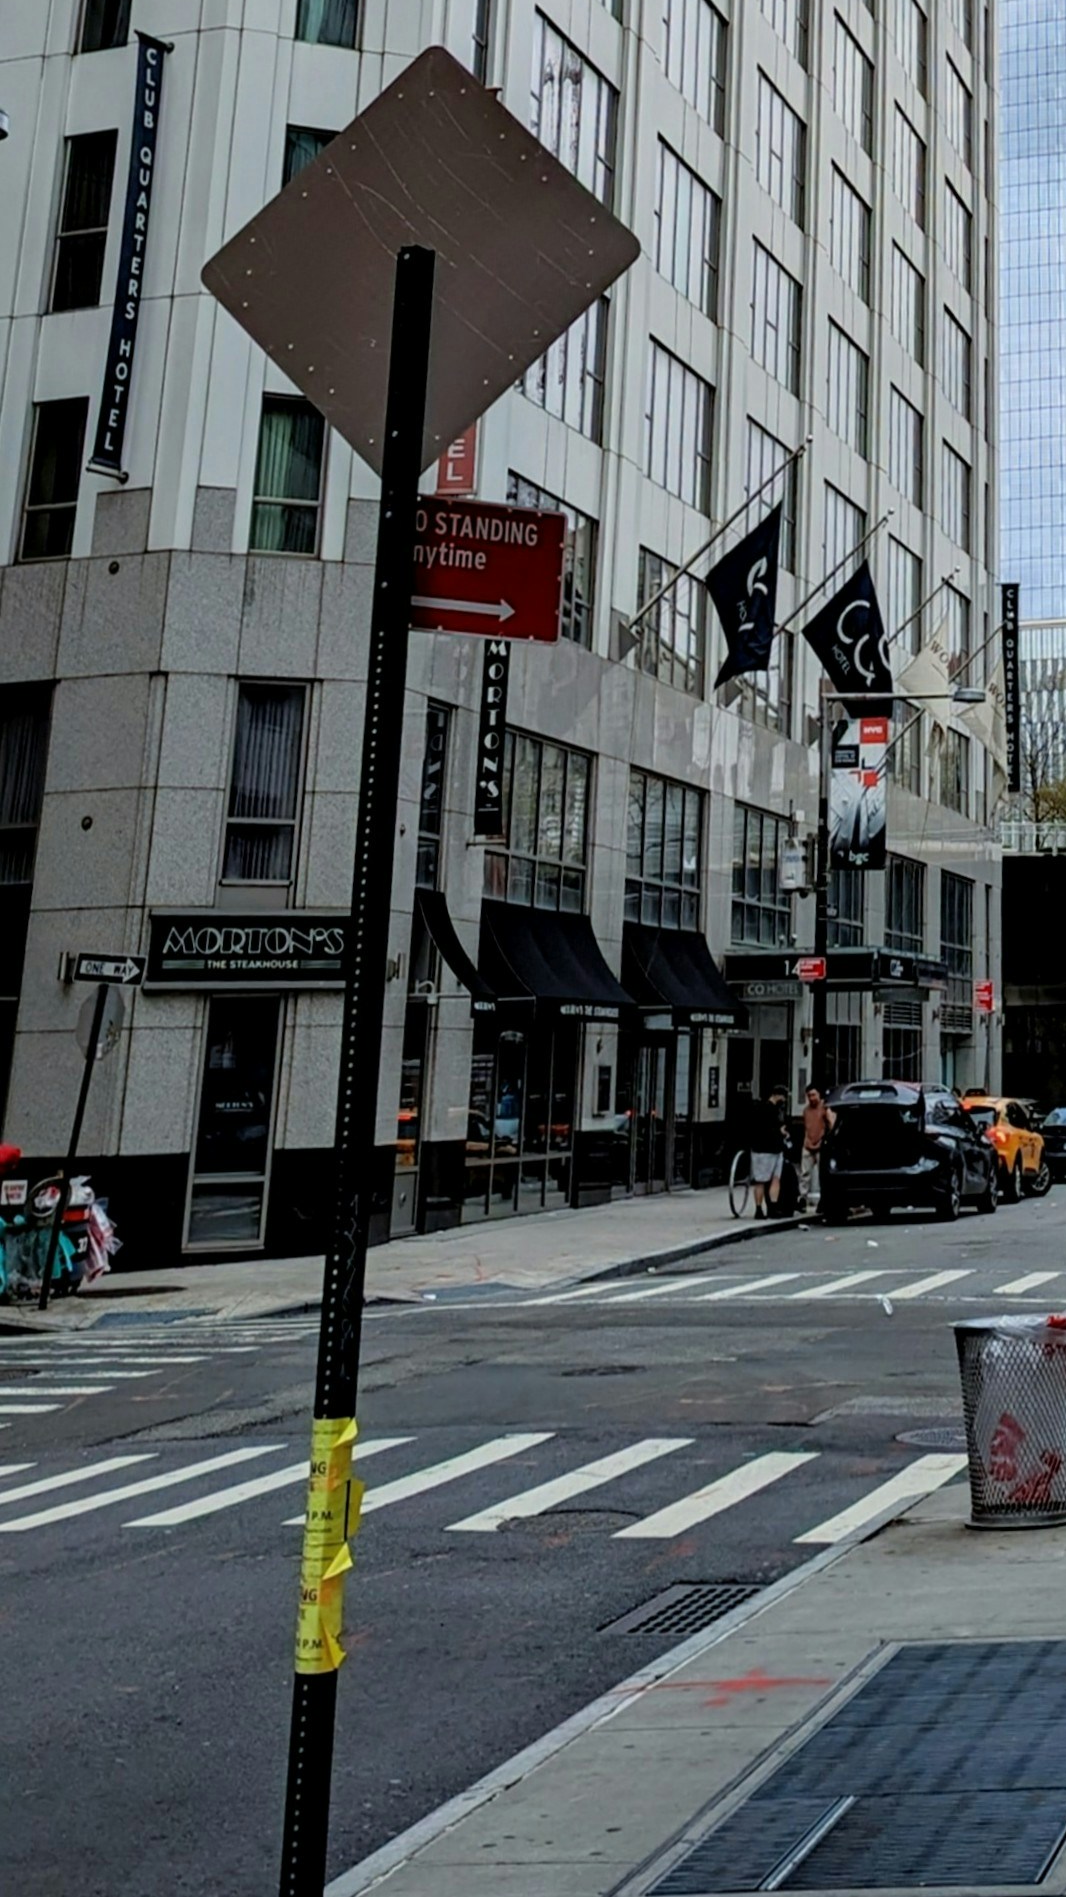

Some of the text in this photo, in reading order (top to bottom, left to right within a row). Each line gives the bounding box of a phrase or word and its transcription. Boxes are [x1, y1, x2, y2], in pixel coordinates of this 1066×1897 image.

[104, 48, 158, 451] CLUB QUARTERS HOTEL
[415, 509, 539, 546] O STANDING
[413, 541, 488, 570] nytime
[1006, 638, 1015, 724] QUARTERS
[479, 640, 508, 798] MORTON'S
[162, 926, 345, 954] MORTON'S
[85, 961, 134, 977] ONE WAY
[207, 959, 299, 970] THE STEAKHOUSE
